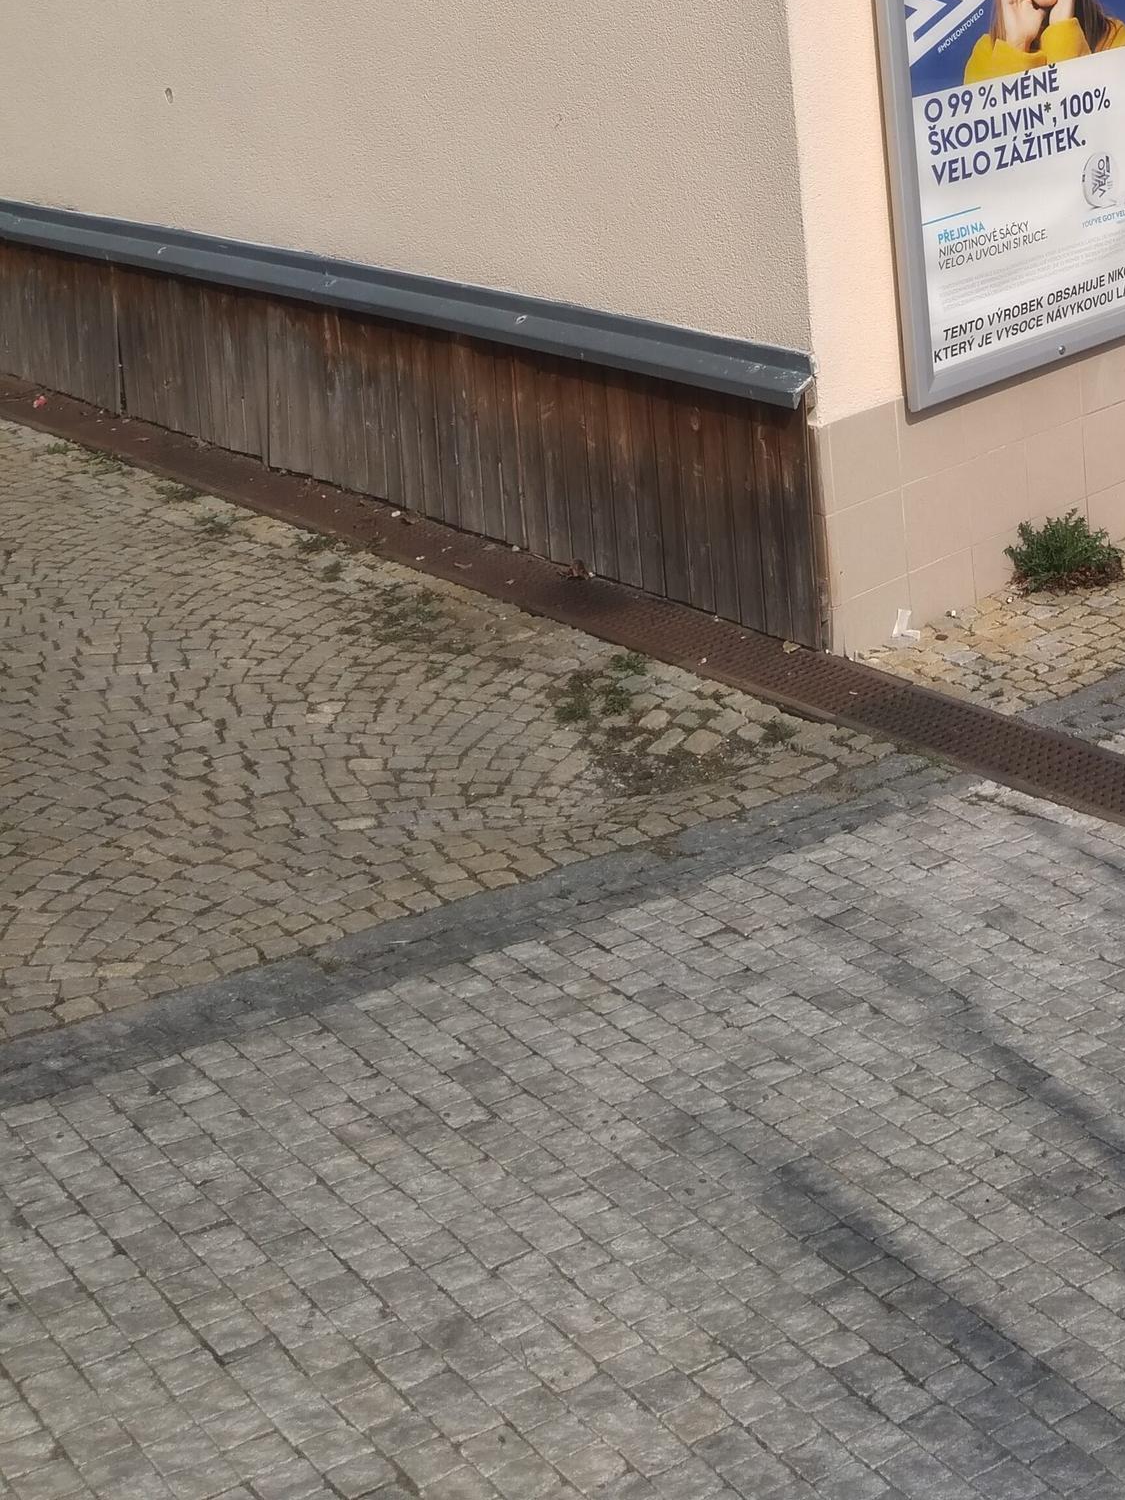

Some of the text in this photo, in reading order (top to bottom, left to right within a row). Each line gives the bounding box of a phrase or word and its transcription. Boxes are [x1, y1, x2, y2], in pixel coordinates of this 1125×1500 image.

[937, 8, 985, 54] #MOVEONTOVELO
[924, 63, 1060, 123] O 99 % MÉNĚ
[1060, 86, 1111, 120] 100%
[931, 124, 1087, 186] VELO ZÁŽITEK.
[937, 221, 986, 244] PŘEJDI NA
[938, 220, 1030, 258] NIKOTINOVÉ SÁČKY
[1102, 213, 1115, 222] GOT
[938, 228, 1048, 271] VELO A UVOLNI SI RUCE.
[933, 338, 975, 364] KTERÝ
[978, 332, 992, 348] JE
[996, 314, 1044, 341] VYSOCE
[1046, 290, 1114, 324] NÁVYKOVOU
[943, 317, 984, 342] TENTO
[987, 296, 1044, 327] VÝROBEK
[1047, 275, 1105, 306] OBSAHUJE
